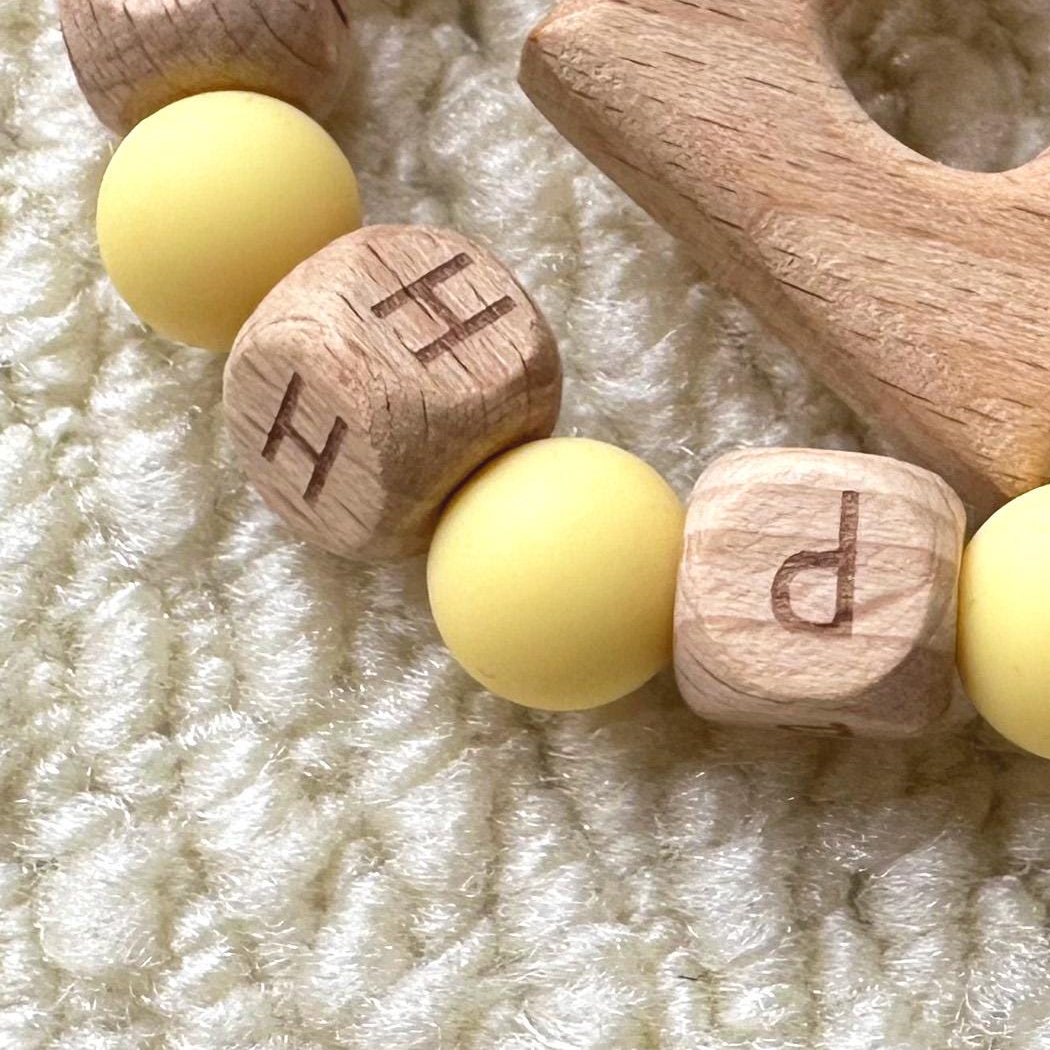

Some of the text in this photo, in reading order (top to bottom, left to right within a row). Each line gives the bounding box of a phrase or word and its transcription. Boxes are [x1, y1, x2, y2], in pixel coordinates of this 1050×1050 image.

[371, 252, 517, 363] H
[261, 371, 348, 504] H
[771, 490, 859, 636] P
